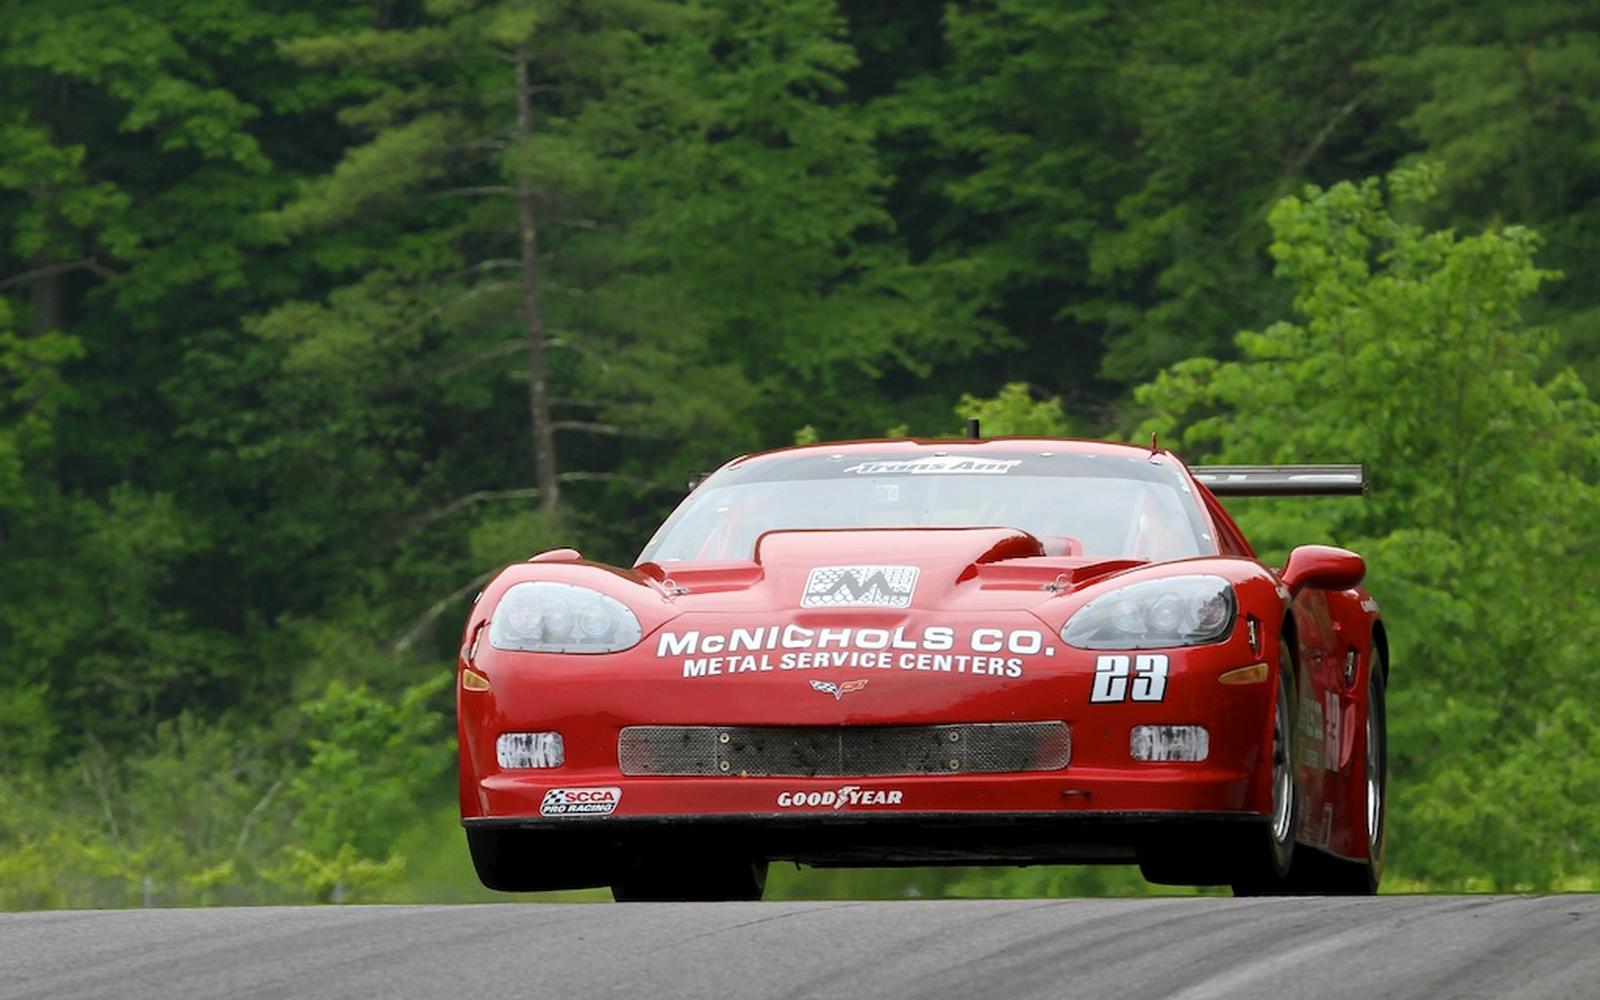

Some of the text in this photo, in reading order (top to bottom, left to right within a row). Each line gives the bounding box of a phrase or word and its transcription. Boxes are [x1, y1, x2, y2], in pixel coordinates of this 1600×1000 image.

[971, 628, 1055, 656] CO.
[683, 651, 1024, 678] METAL SERVICE CENTERS
[1089, 654, 1169, 704] 23
[543, 803, 612, 814] PRO RACING
[565, 791, 614, 802] SCCA
